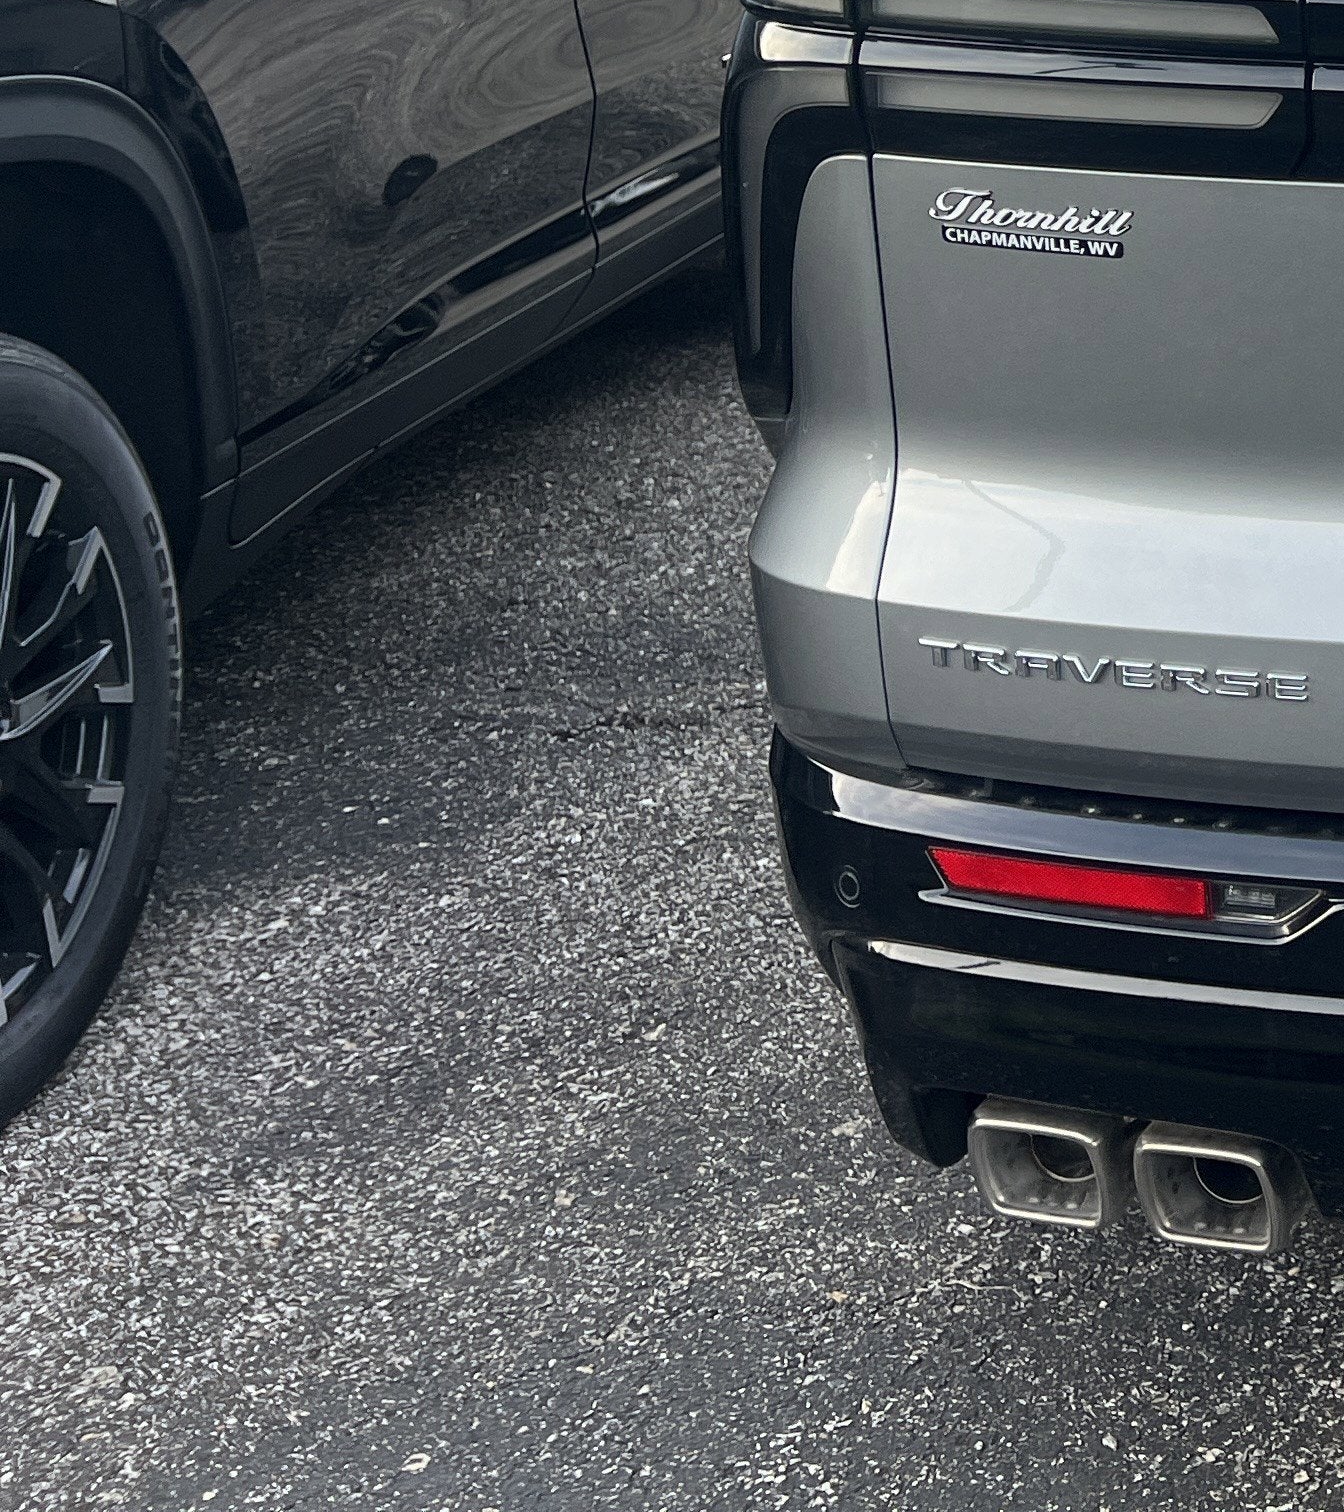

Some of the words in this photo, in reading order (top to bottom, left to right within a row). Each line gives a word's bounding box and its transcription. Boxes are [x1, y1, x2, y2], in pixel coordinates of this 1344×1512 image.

[928, 187, 1134, 236] Thornhill
[945, 227, 1085, 255] CHAPMANVILLE,
[1088, 241, 1119, 256] WV
[918, 636, 1308, 701] TRAVERSE
